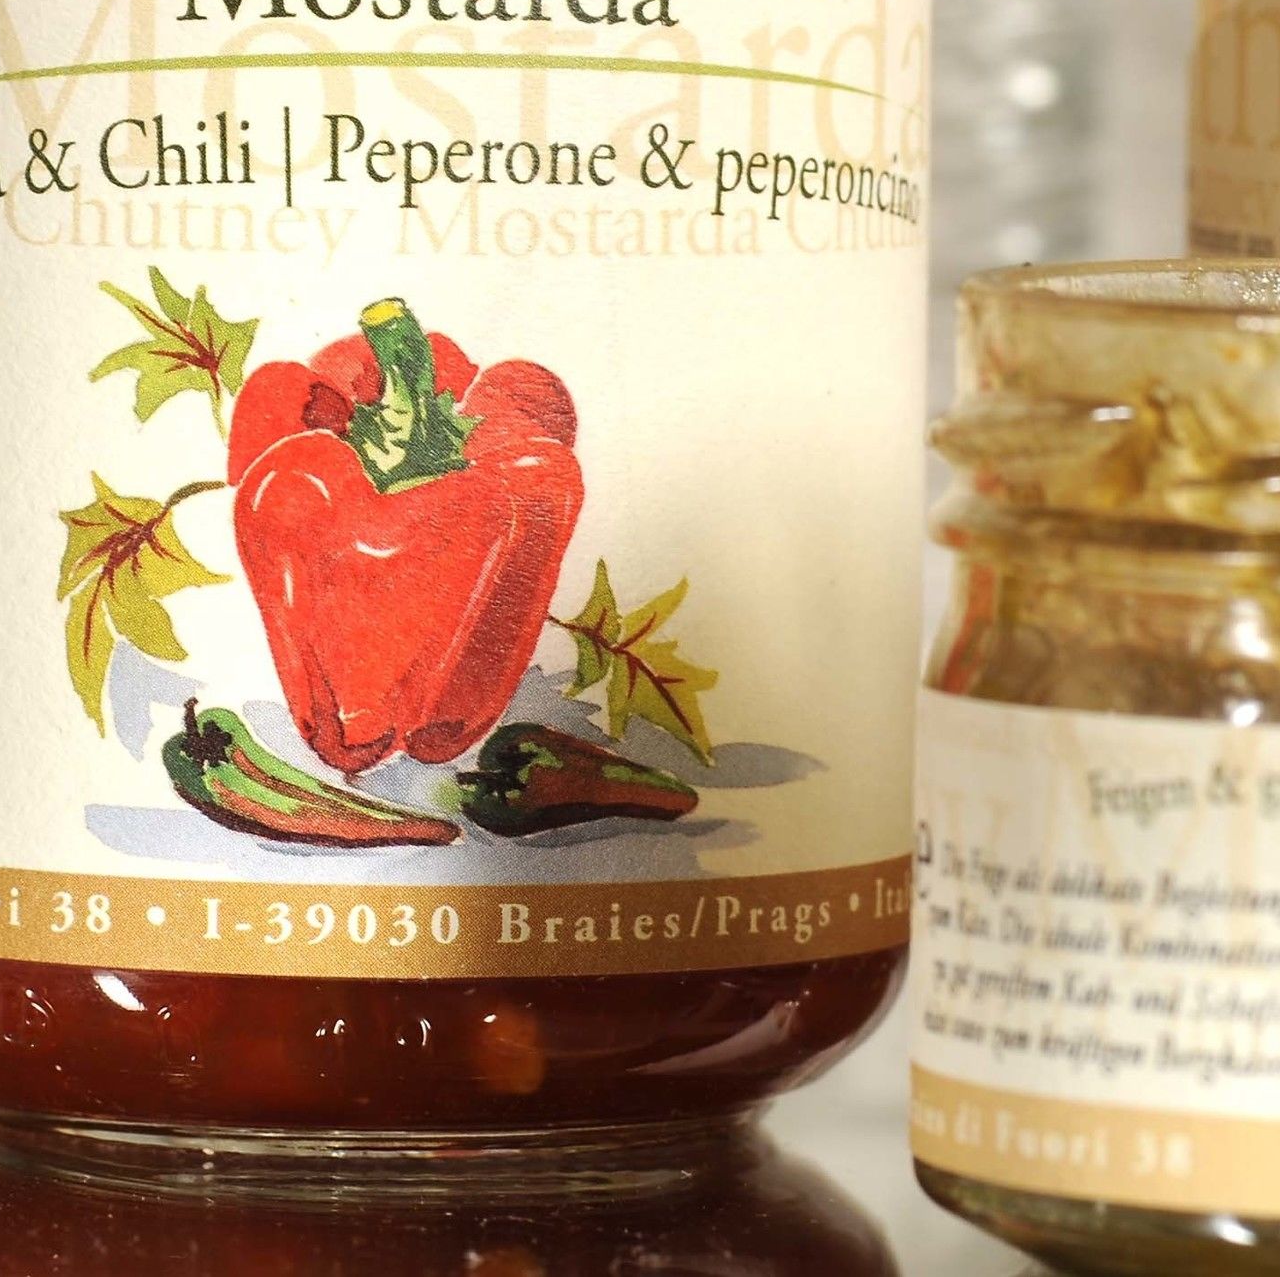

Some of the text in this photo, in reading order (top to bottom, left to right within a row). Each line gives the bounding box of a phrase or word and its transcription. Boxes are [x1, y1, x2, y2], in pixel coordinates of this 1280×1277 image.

[24, 128, 78, 194] &
[98, 111, 256, 189] Chili
[322, 113, 617, 209] Peperone
[639, 123, 696, 190] &
[50, 891, 113, 934] 38
[202, 897, 461, 947] I-39030
[496, 895, 831, 944] Braies/Prags
